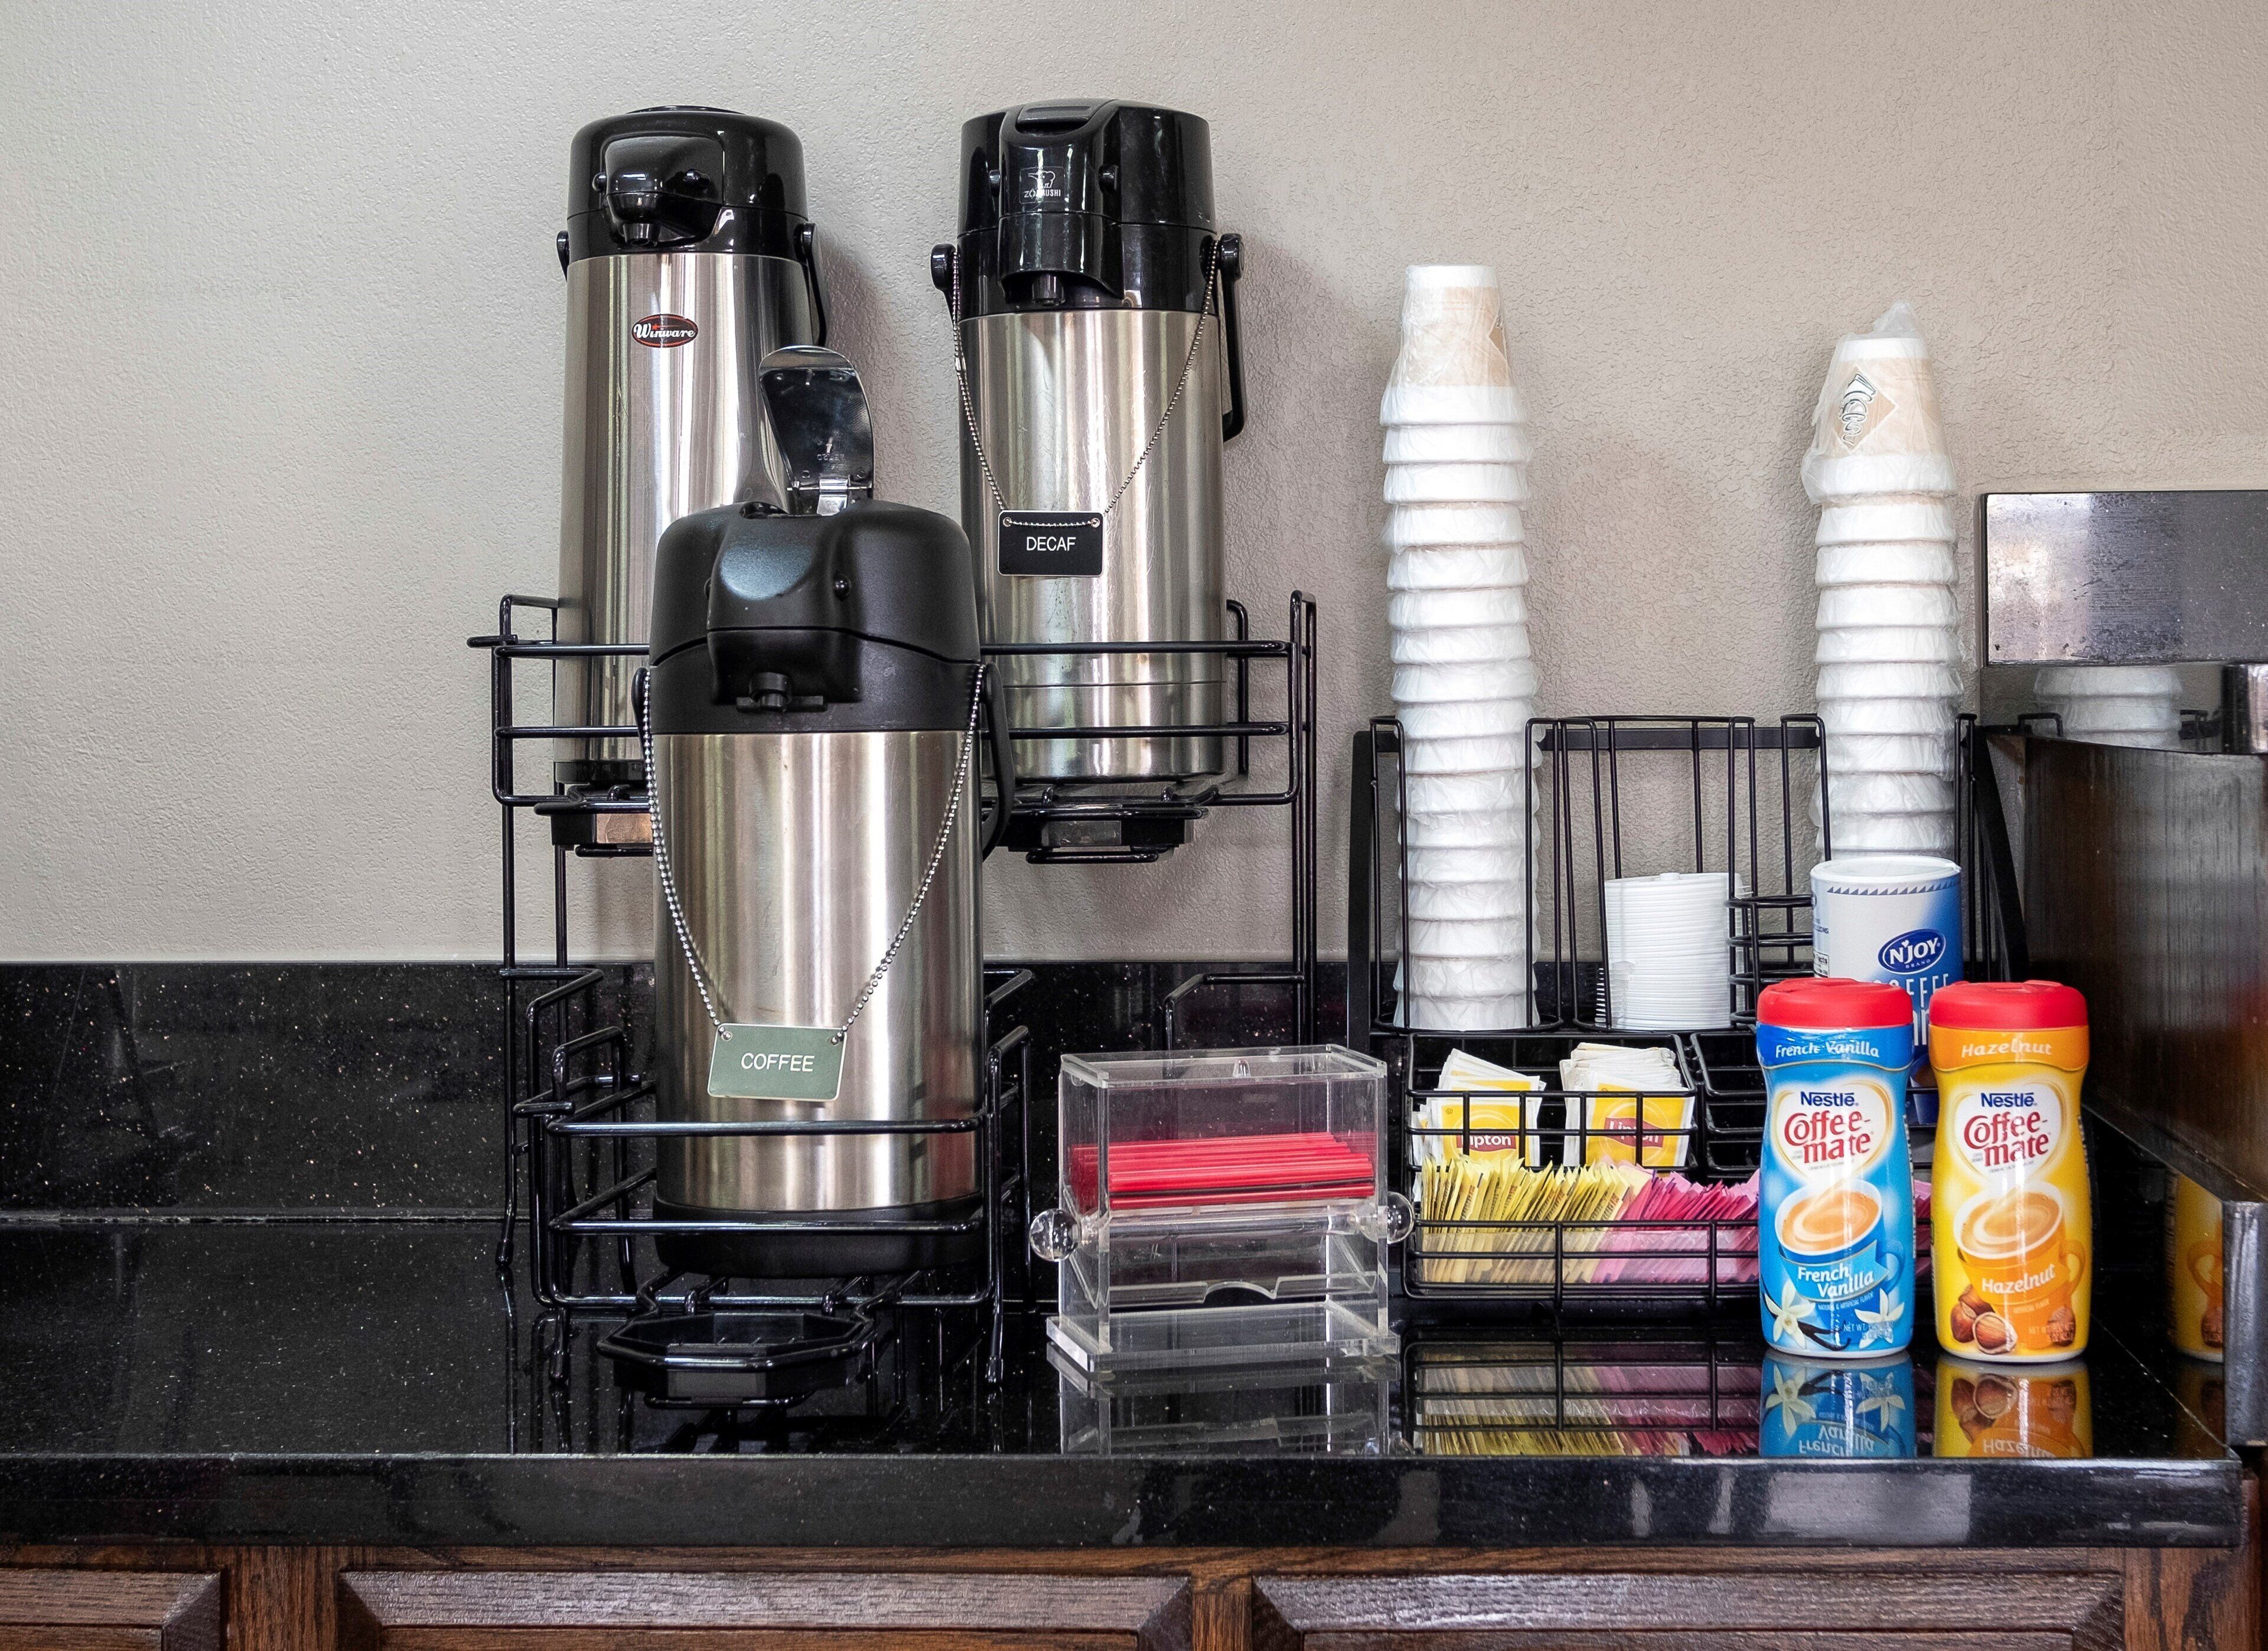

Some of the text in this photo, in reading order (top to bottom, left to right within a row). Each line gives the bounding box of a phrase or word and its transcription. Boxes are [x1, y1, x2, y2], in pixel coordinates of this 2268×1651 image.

[633, 323, 695, 338] Winware
[1026, 536, 1076, 552] DECAF
[1905, 959, 1931, 969] BRAND
[1775, 1040, 1879, 1058] French Vanilla
[1961, 1038, 2052, 1059] Hazelnut
[741, 1052, 815, 1072] COFFEE
[1800, 1091, 1855, 1107] Nestlé
[1980, 1092, 2034, 1108] Nestlé
[1804, 1133, 1871, 1164] mate
[1983, 1133, 2049, 1167] mate
[1797, 1262, 1850, 1283] French
[1982, 1264, 2056, 1294] Hazelnut
[1817, 1271, 1874, 1297] Vanilla
